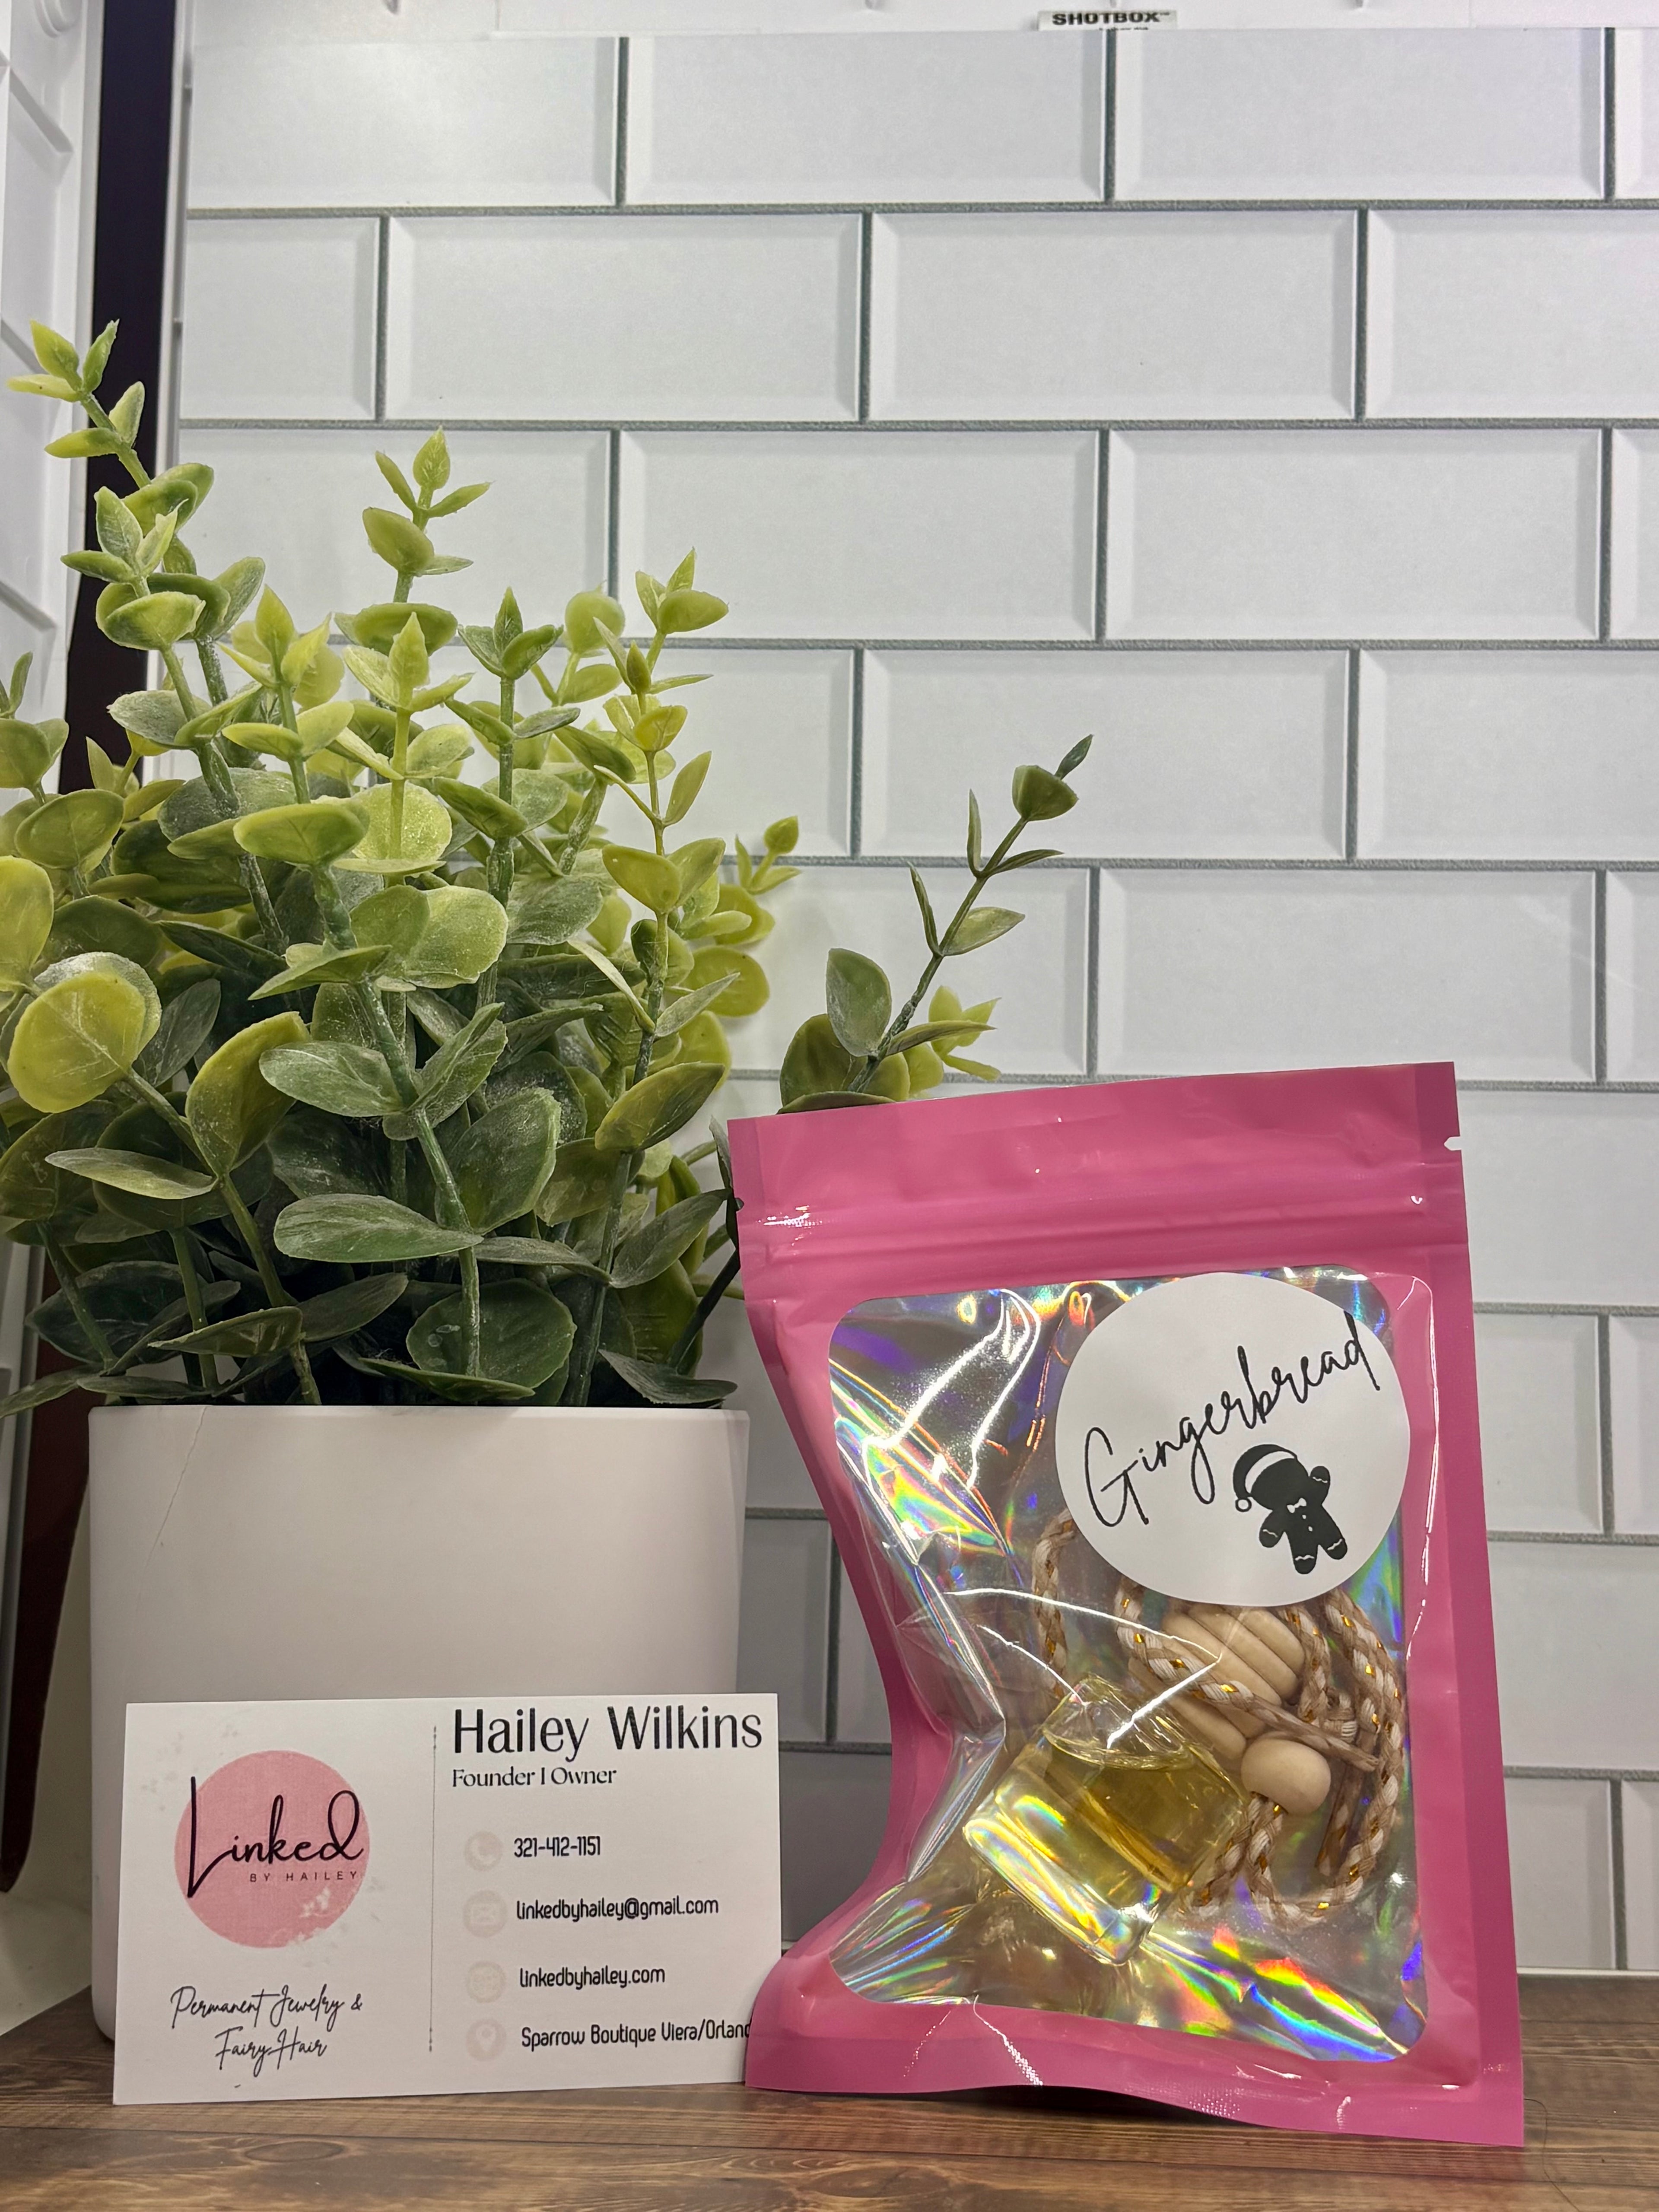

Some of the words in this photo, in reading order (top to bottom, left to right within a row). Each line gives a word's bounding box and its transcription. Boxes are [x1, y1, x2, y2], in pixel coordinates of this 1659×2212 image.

[1084, 1310, 1380, 1527] Gingerbread
[454, 1707, 590, 1763] Hailey
[607, 1704, 763, 1750] Wilkins
[452, 1766, 536, 1787] Founder
[550, 1767, 617, 1785] Owner
[186, 1776, 365, 1899] Linked
[514, 1835, 601, 1858] 321-412-1151
[249, 1872, 271, 1883] BY
[285, 1870, 357, 1882] HAILEY
[516, 1894, 719, 1923] linkedbyhailey@gmail.com
[519, 1964, 666, 1991] linkedbyhailey.com
[170, 1986, 280, 2029] Permanent
[270, 1983, 345, 2032] Jewelry
[350, 1993, 363, 2011] &
[214, 2026, 272, 2077] Fairy
[267, 2026, 327, 2070] Hair
[521, 2026, 586, 2053] Sparrow
[590, 2023, 657, 2048] Boutique
